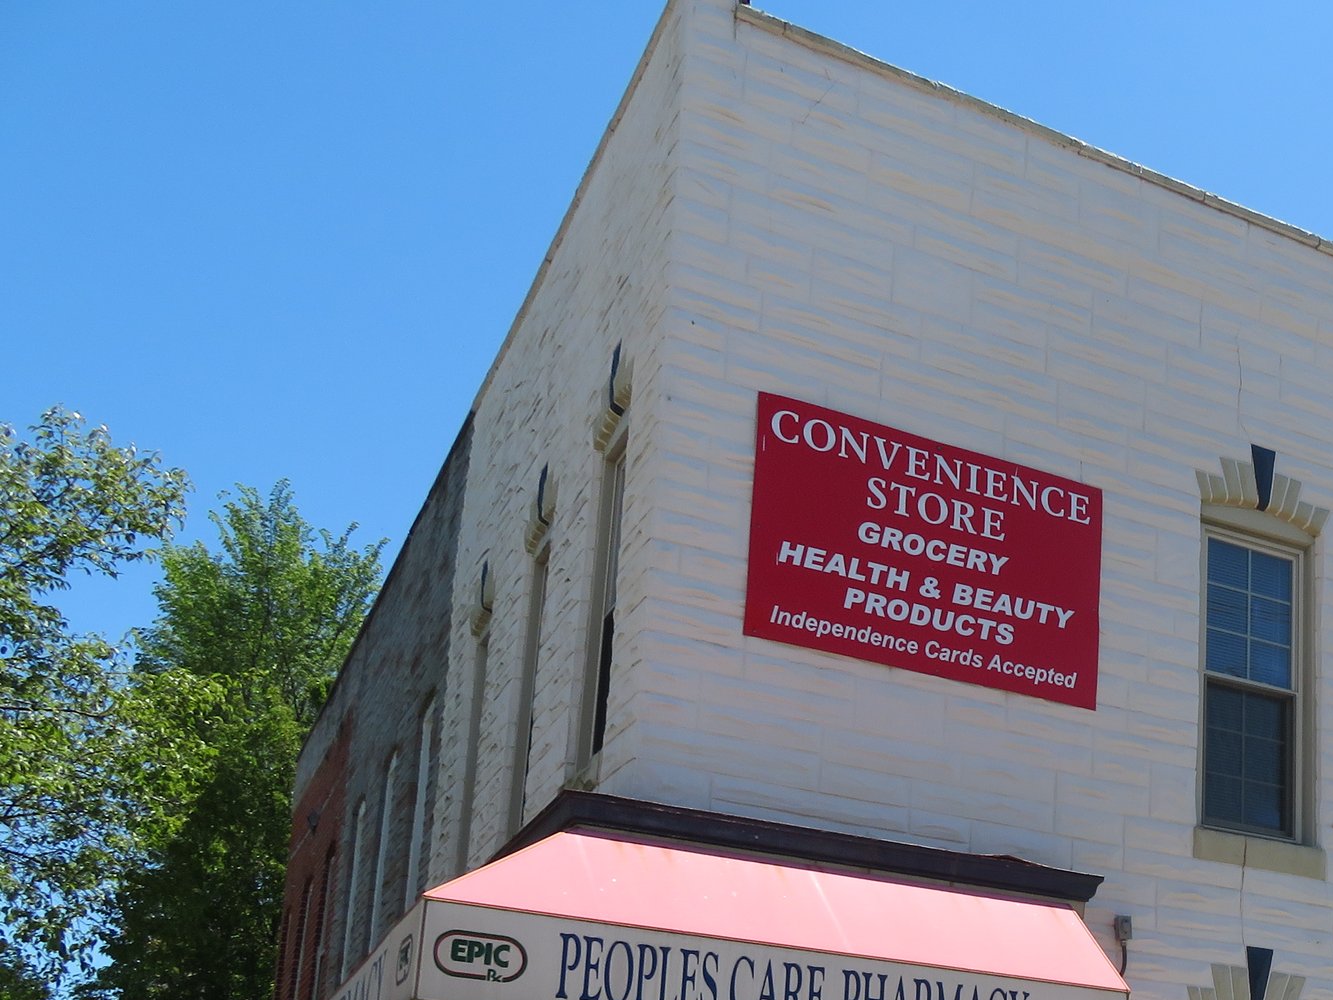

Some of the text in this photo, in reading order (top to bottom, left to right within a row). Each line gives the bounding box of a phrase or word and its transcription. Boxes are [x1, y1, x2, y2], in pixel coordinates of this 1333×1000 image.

[771, 410, 1091, 525] CONVENIENCE
[866, 477, 1006, 541] STORE
[857, 521, 1009, 576] GROCERY
[777, 541, 1075, 629] HEALTH & BEAUTY
[843, 587, 1016, 645] PRODUCTS
[770, 605, 1077, 689] Independence Cards Accepted
[450, 938, 511, 969] EPIC
